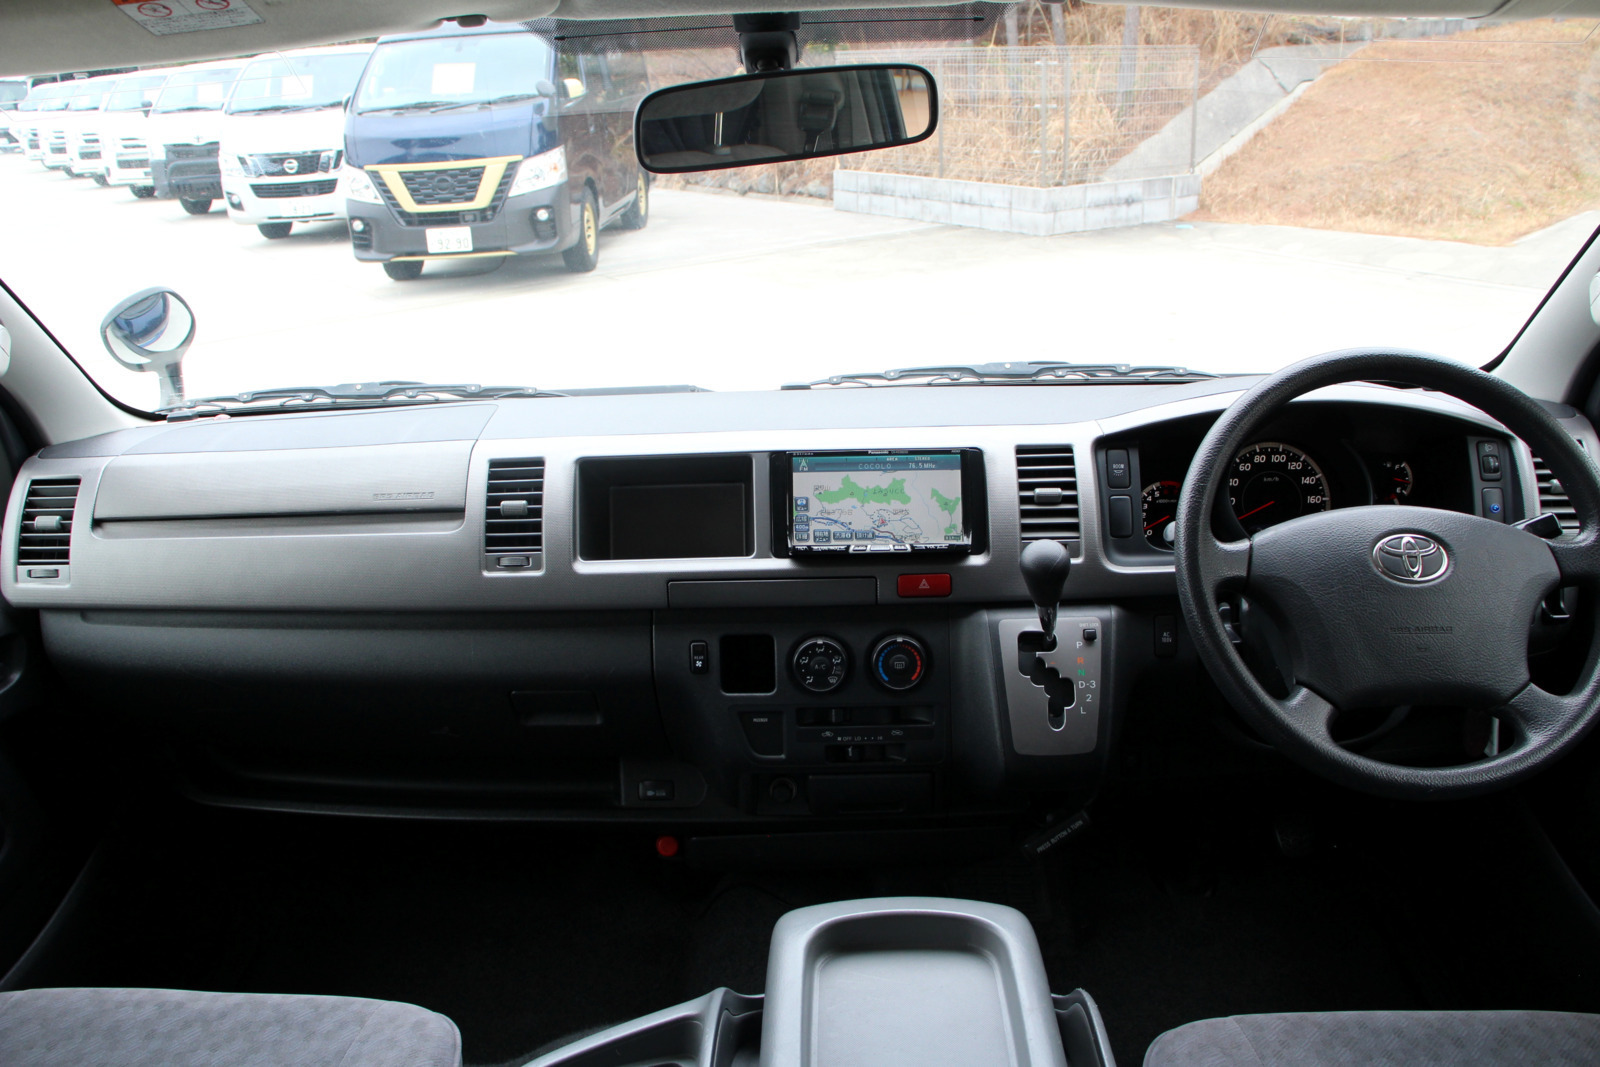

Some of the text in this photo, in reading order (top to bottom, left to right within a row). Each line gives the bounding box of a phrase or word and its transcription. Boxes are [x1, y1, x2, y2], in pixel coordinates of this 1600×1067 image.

[1254, 454, 1266, 463] 80
[1271, 454, 1286, 463] 100
[1239, 463, 1251, 471] 60
[1288, 462, 1302, 470] 120
[1301, 476, 1316, 485] 140
[1307, 495, 1322, 504] 160
[1076, 641, 1083, 649] P
[1077, 656, 1084, 664] R
[1078, 680, 1096, 689] D-3
[1086, 694, 1092, 702] 2
[1080, 706, 1087, 714] L
